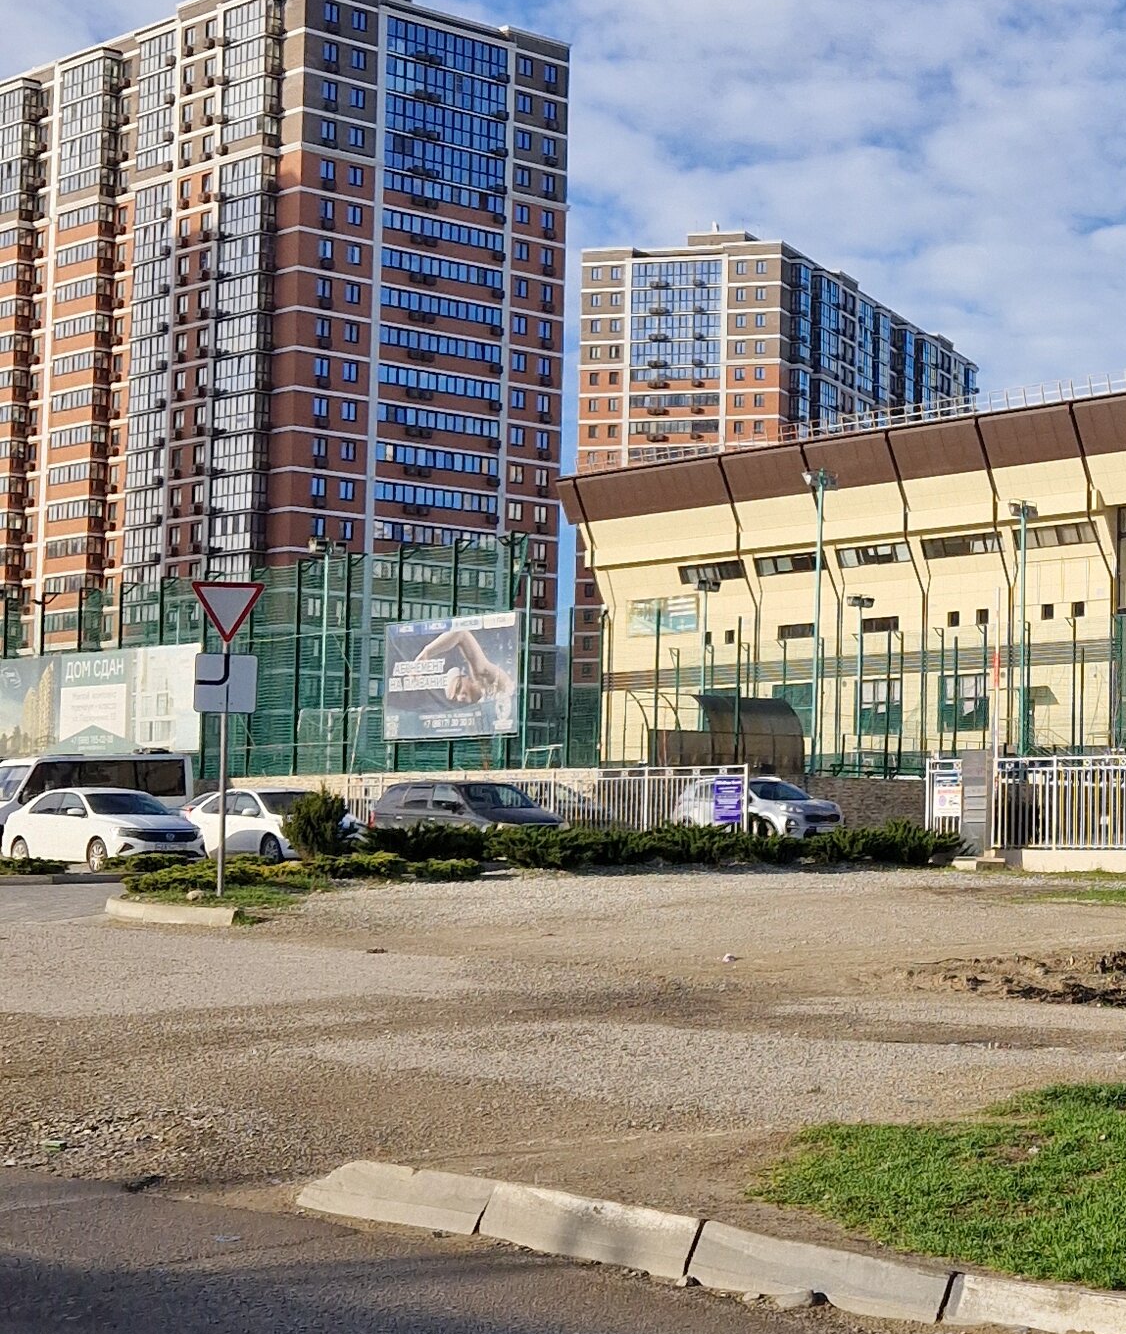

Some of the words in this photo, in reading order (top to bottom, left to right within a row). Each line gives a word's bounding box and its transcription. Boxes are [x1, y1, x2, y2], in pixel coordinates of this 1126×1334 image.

[65, 661, 91, 682] ДОМ
[93, 658, 124, 679] СДАН
[393, 659, 444, 676] АБОНЕМЕНТ
[389, 677, 402, 691] НА
[404, 674, 449, 690] ПЛАВАНИЕ
